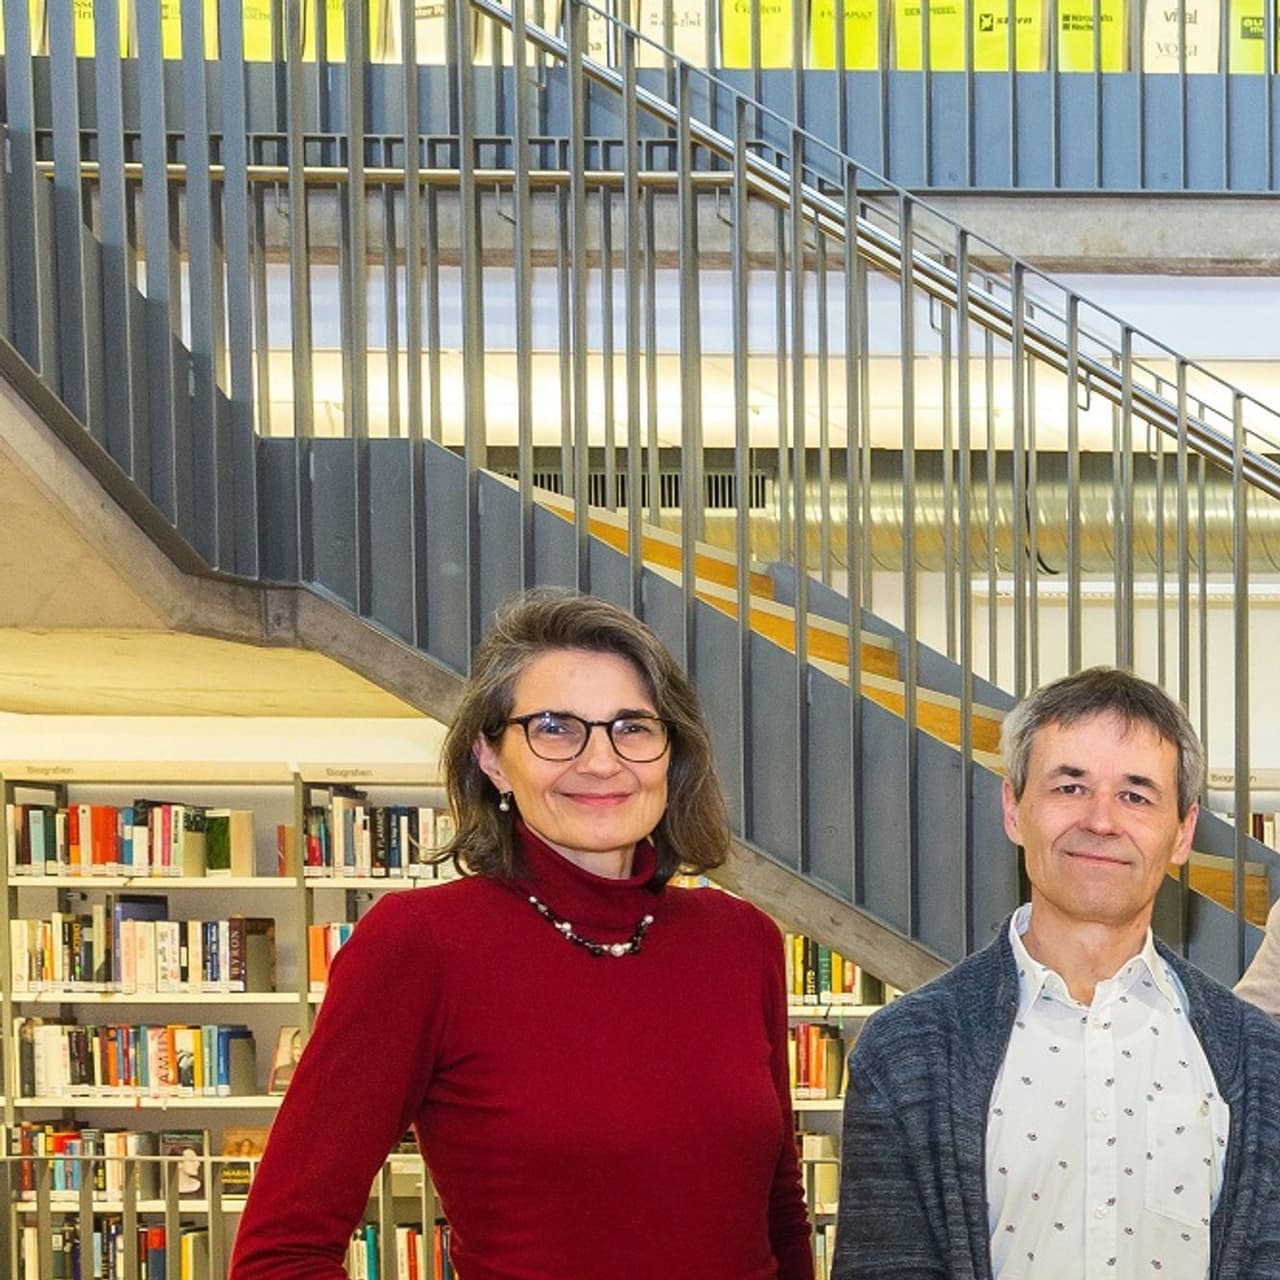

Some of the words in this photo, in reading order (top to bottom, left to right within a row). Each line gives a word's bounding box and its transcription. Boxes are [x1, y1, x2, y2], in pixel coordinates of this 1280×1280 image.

[996, 16, 1033, 25] strn
[326, 767, 373, 777] Biografien
[231, 930, 240, 975] BYRON
